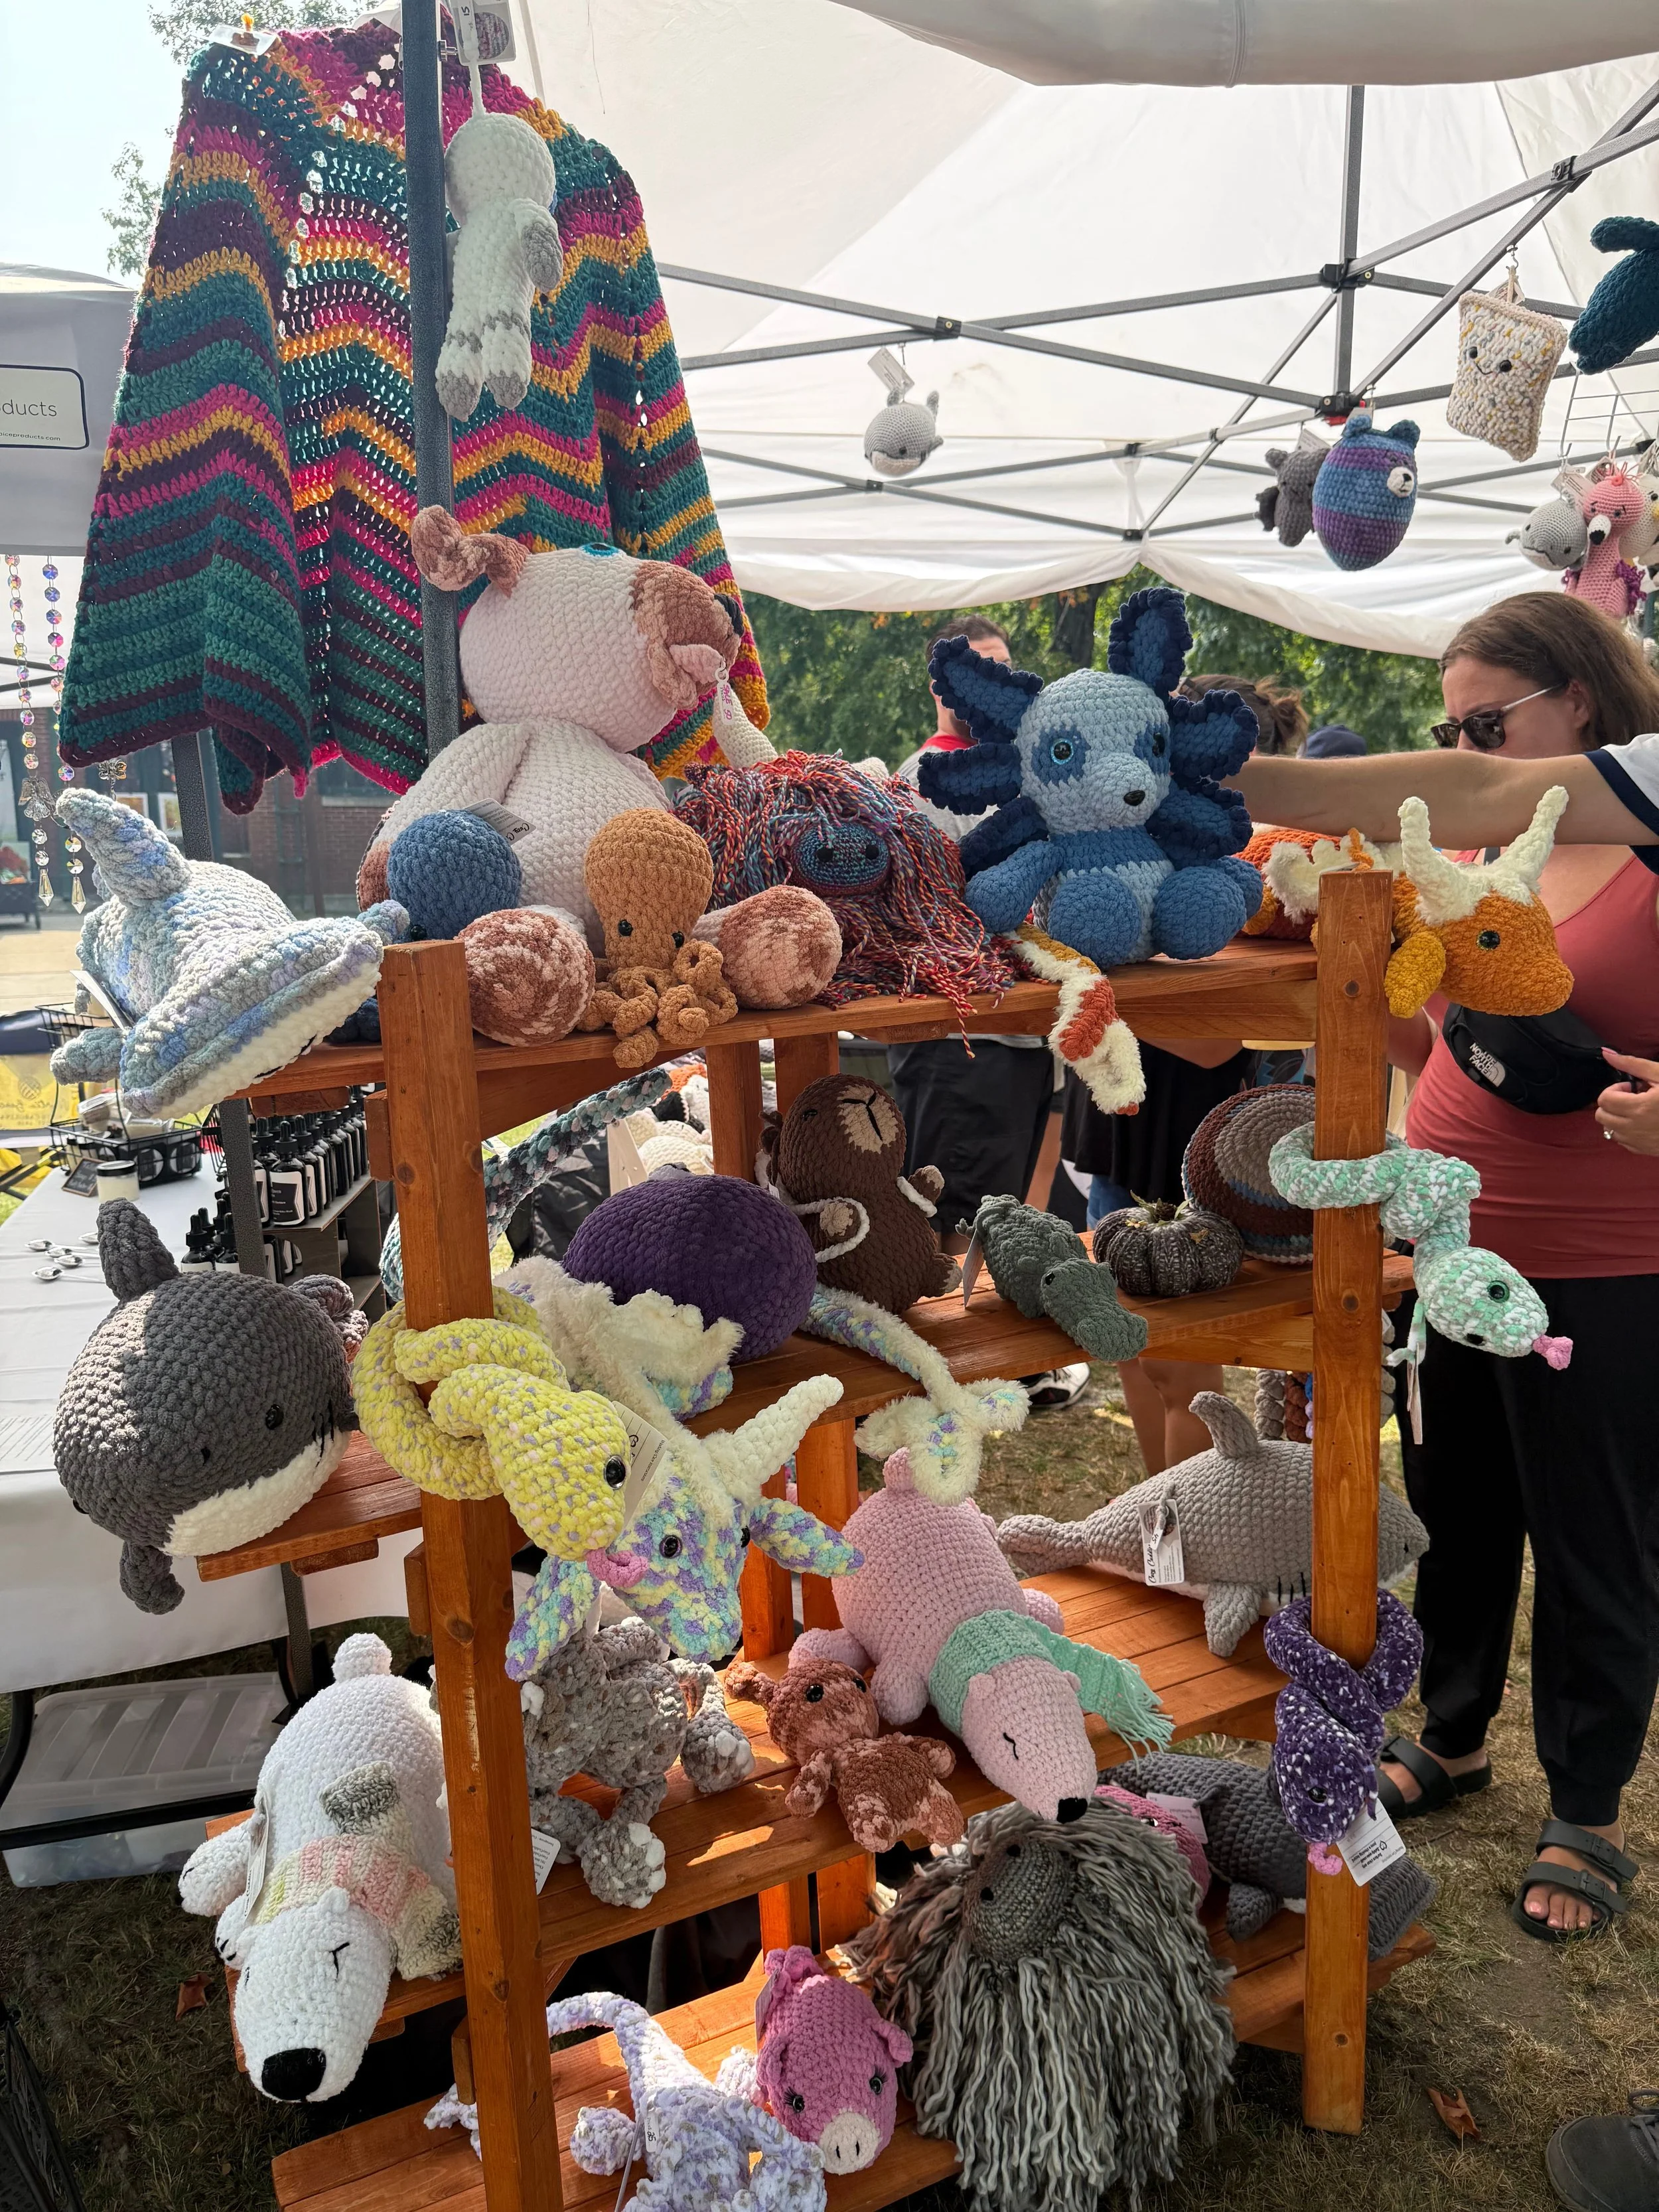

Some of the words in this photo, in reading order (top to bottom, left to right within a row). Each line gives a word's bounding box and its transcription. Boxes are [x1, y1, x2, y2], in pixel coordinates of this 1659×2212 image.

[0, 399, 57, 417] ducts
[1469, 1042, 1493, 1070] NORTH
[1469, 1055, 1488, 1076] FACE
[647, 2131, 656, 2141] 25
